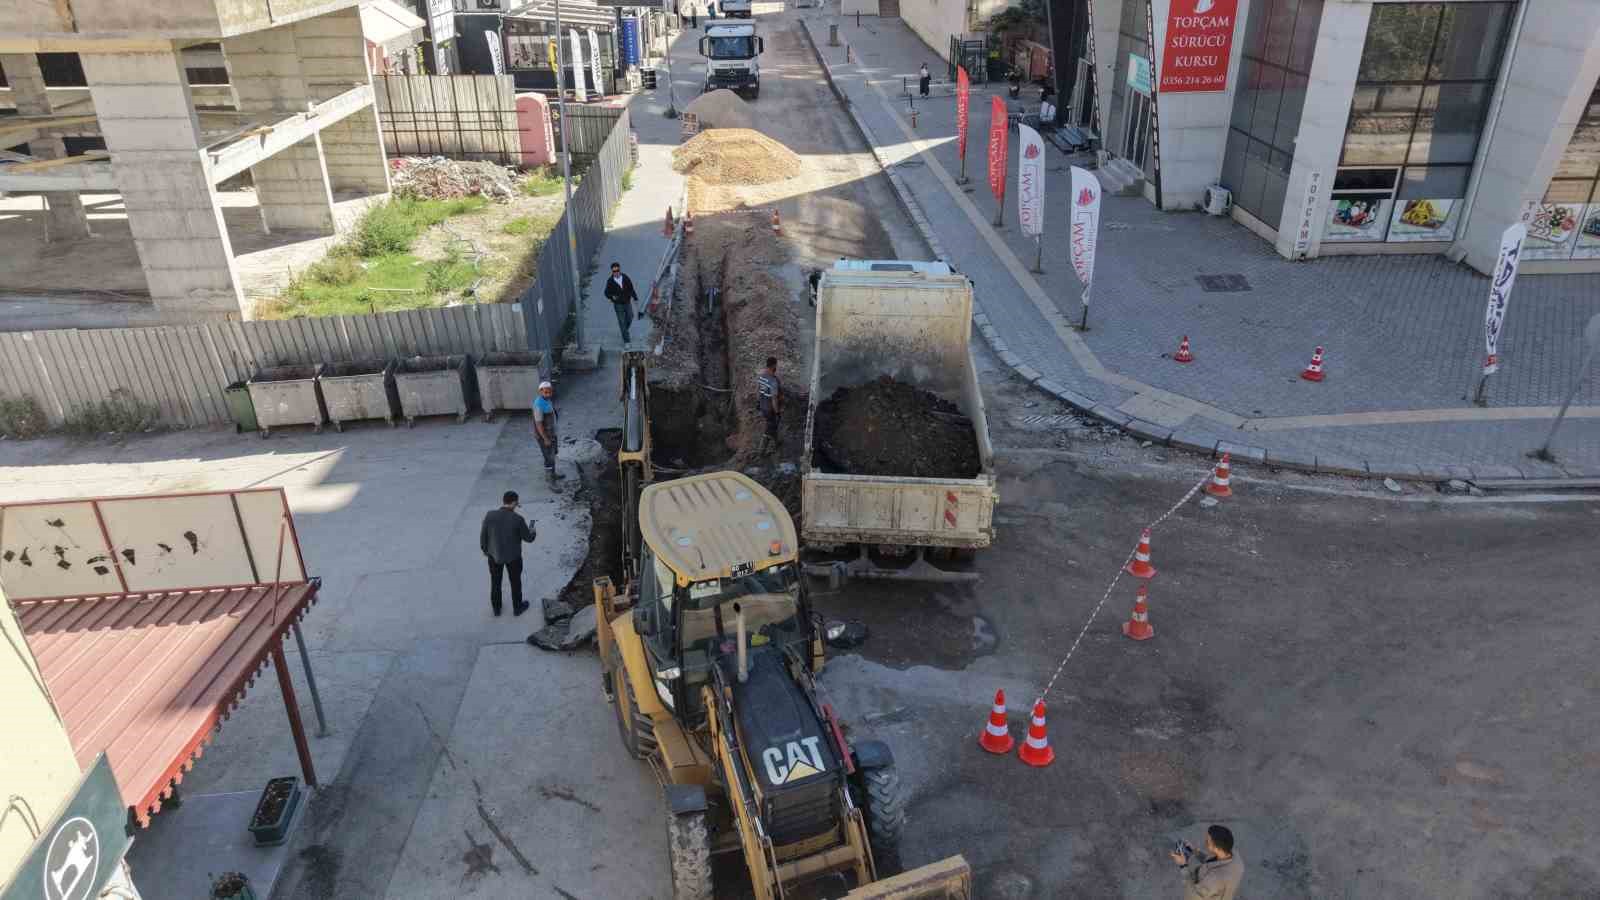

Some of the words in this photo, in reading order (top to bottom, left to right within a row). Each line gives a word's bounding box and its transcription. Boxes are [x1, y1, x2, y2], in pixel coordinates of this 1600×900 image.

[1174, 16, 1229, 30] TOPÇAM
[1171, 33, 1226, 48] SÜRÜCÜ
[1175, 55, 1218, 67] KURSU
[762, 736, 826, 785] CAT
